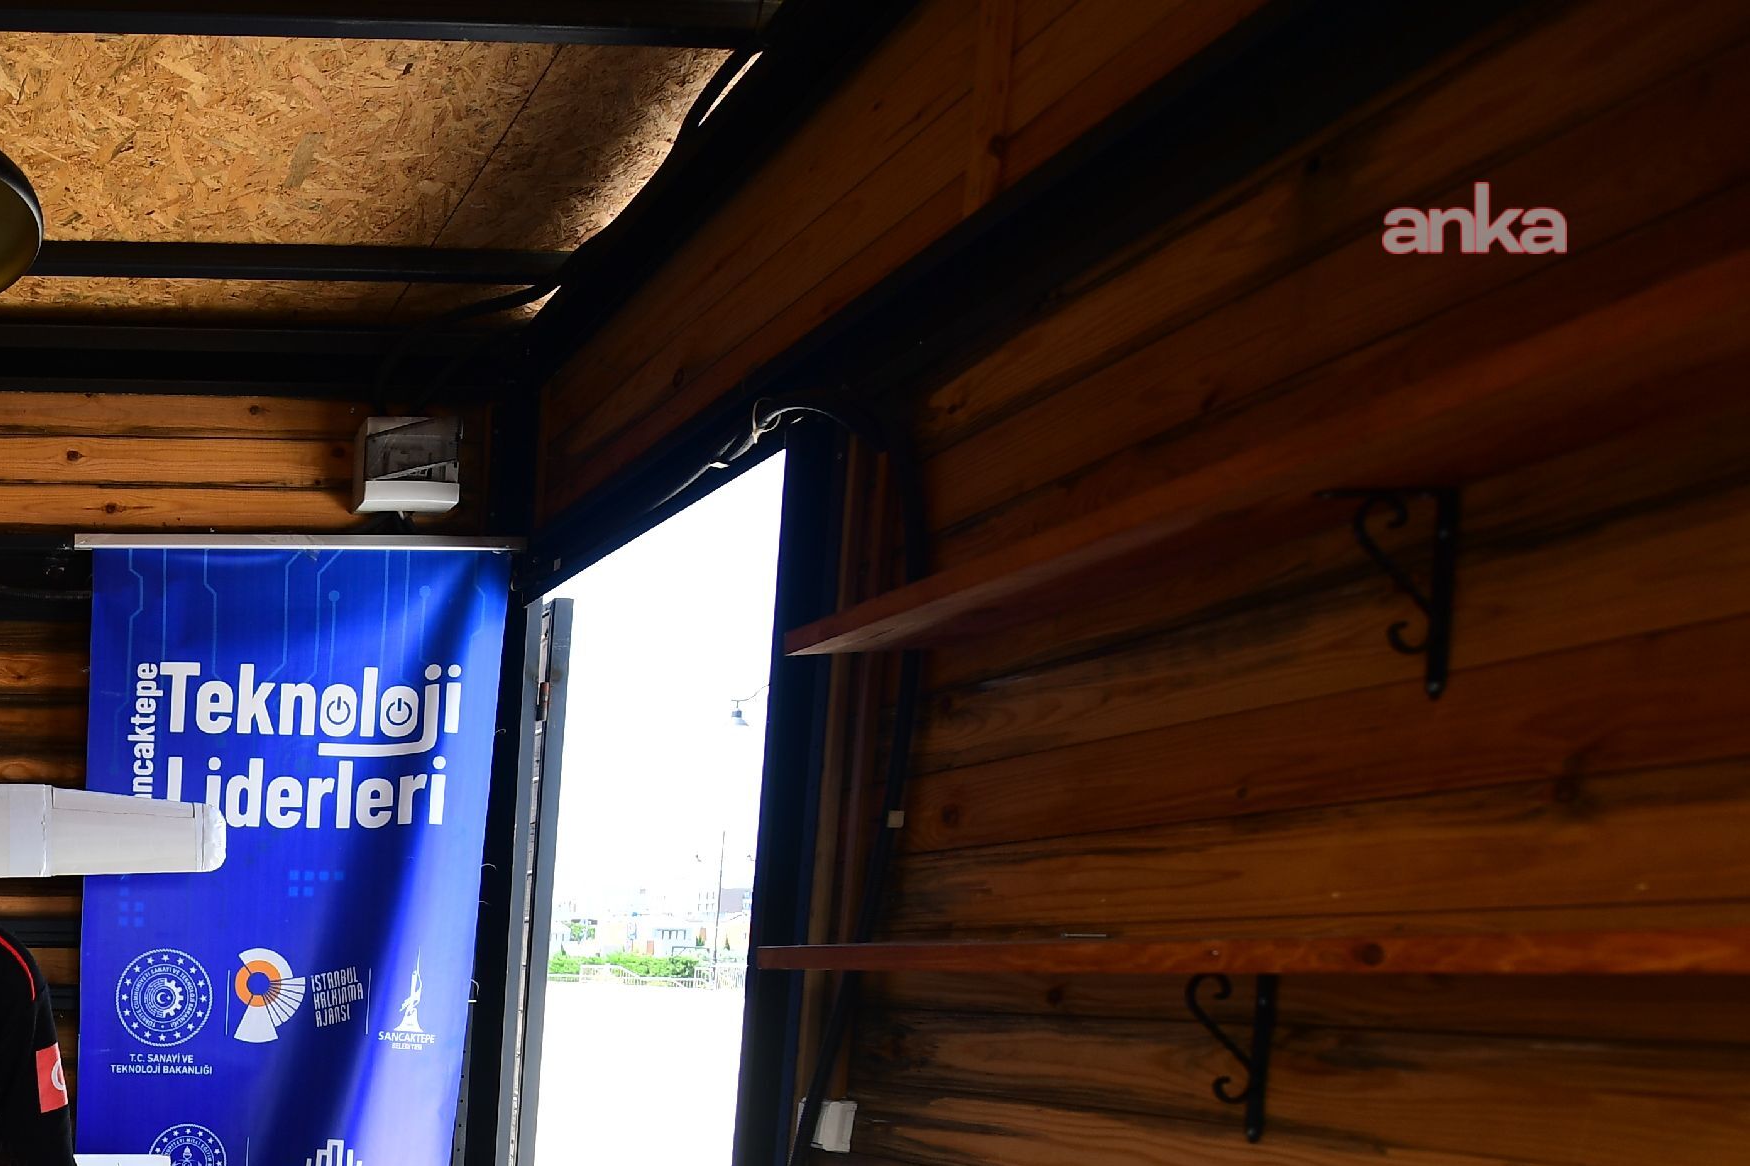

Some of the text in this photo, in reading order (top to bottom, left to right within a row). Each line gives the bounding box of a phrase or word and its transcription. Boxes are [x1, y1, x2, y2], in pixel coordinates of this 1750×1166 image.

[160, 662, 462, 757] Teknoloji
[127, 663, 164, 799] ncaktepe
[377, 1031, 436, 1044] SANCAKTEPE
[129, 1052, 194, 1064] T.C. SANAYİ VE
[110, 1064, 213, 1075] TEKNOLOJİ BAKANLIĞI
